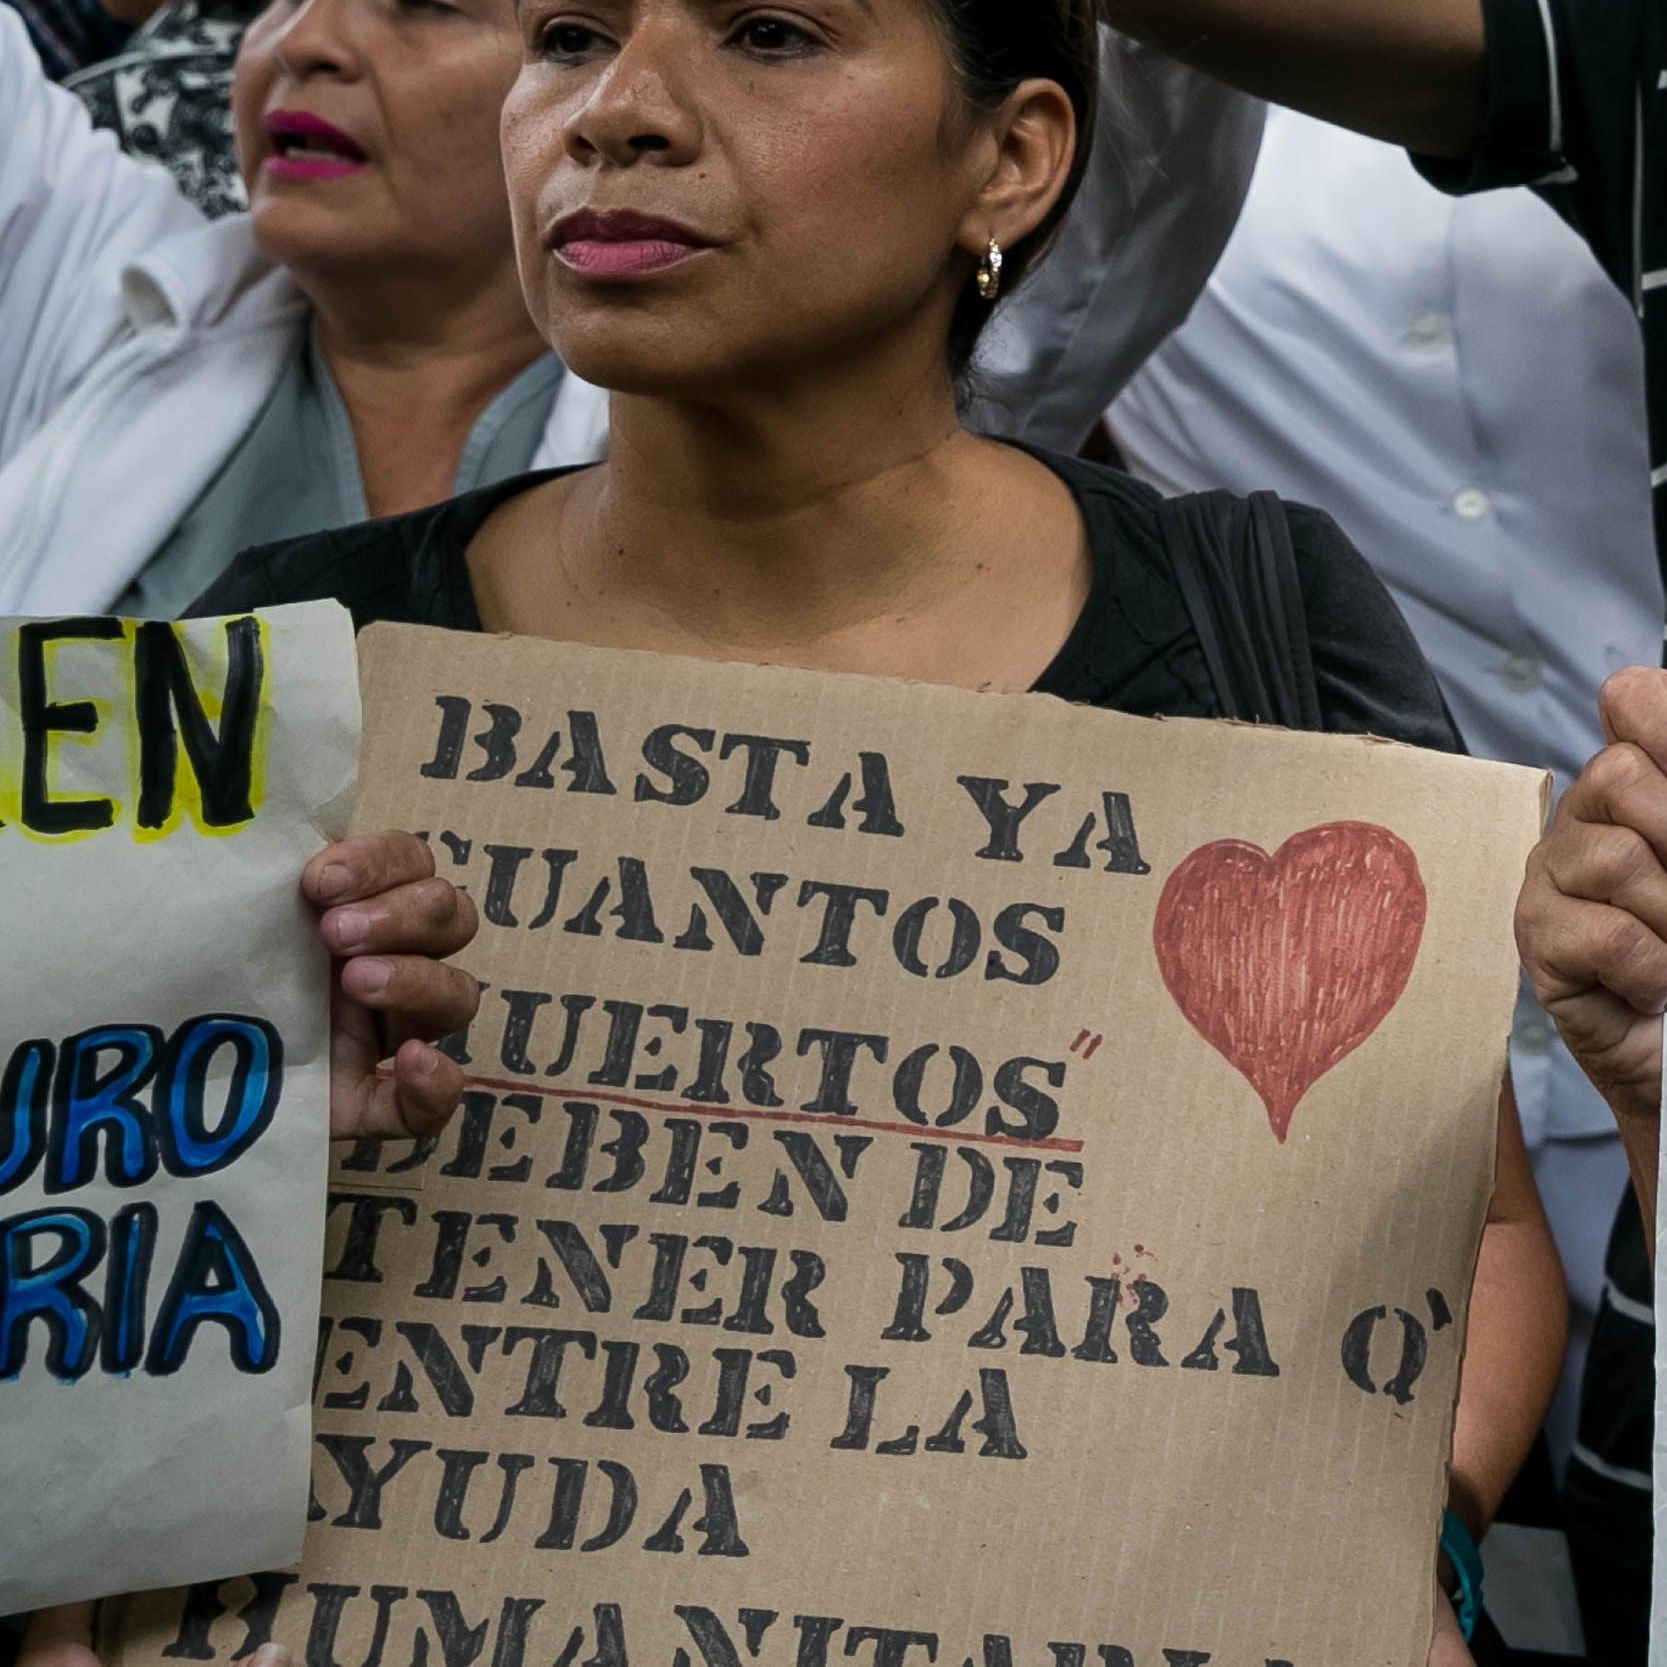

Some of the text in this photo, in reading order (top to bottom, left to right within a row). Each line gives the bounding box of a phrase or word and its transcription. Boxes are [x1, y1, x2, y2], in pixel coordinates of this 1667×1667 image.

[0, 616, 264, 832] EN
[421, 696, 1150, 874] BASTA YA
[899, 1143, 1082, 1246] DE
[324, 1192, 825, 1338] TENER
[881, 1253, 1279, 1376] PARA
[312, 1316, 1027, 1459] ENTRE LA
[308, 1434, 748, 1557] YUDA
